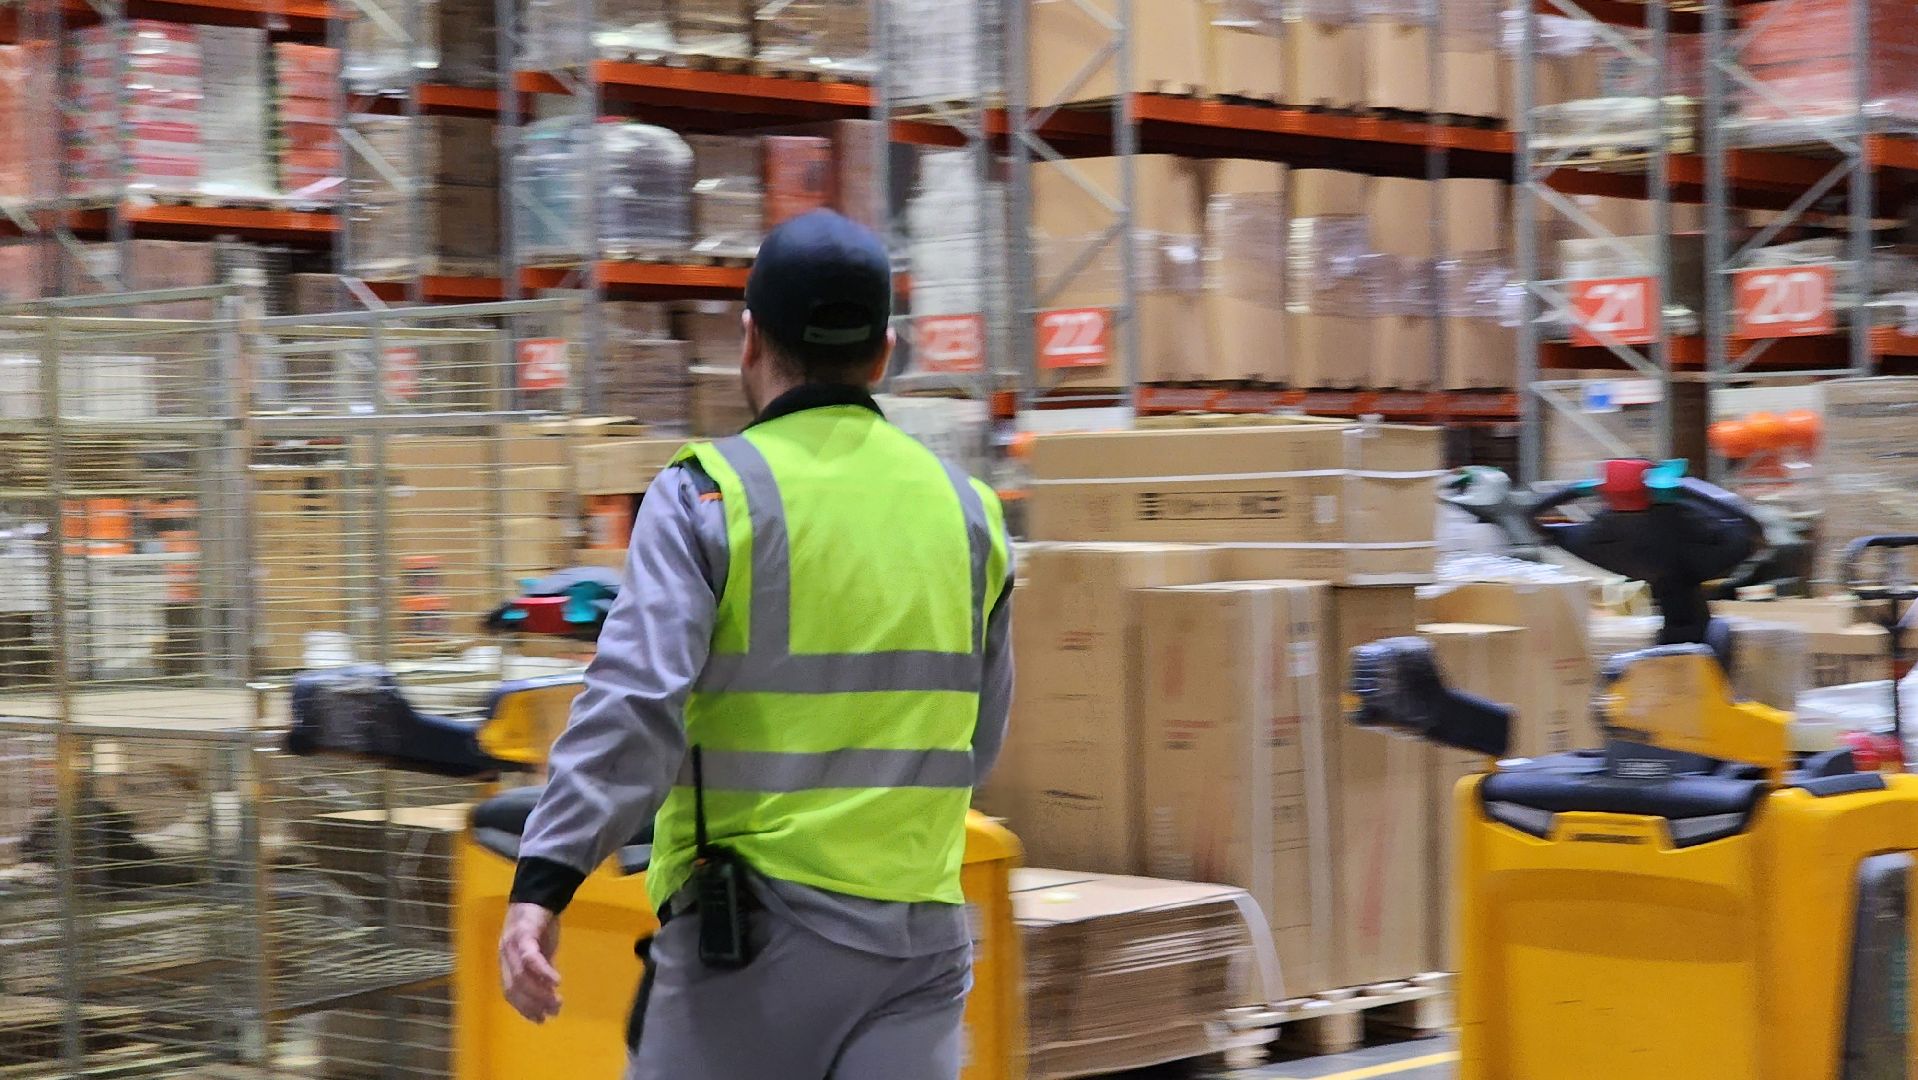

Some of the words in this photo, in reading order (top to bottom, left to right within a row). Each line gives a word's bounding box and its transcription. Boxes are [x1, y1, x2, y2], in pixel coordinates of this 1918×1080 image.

[1584, 283, 1644, 332] 21
[1743, 272, 1825, 323] 20
[921, 319, 981, 360] 23
[1041, 312, 1104, 355] 22
